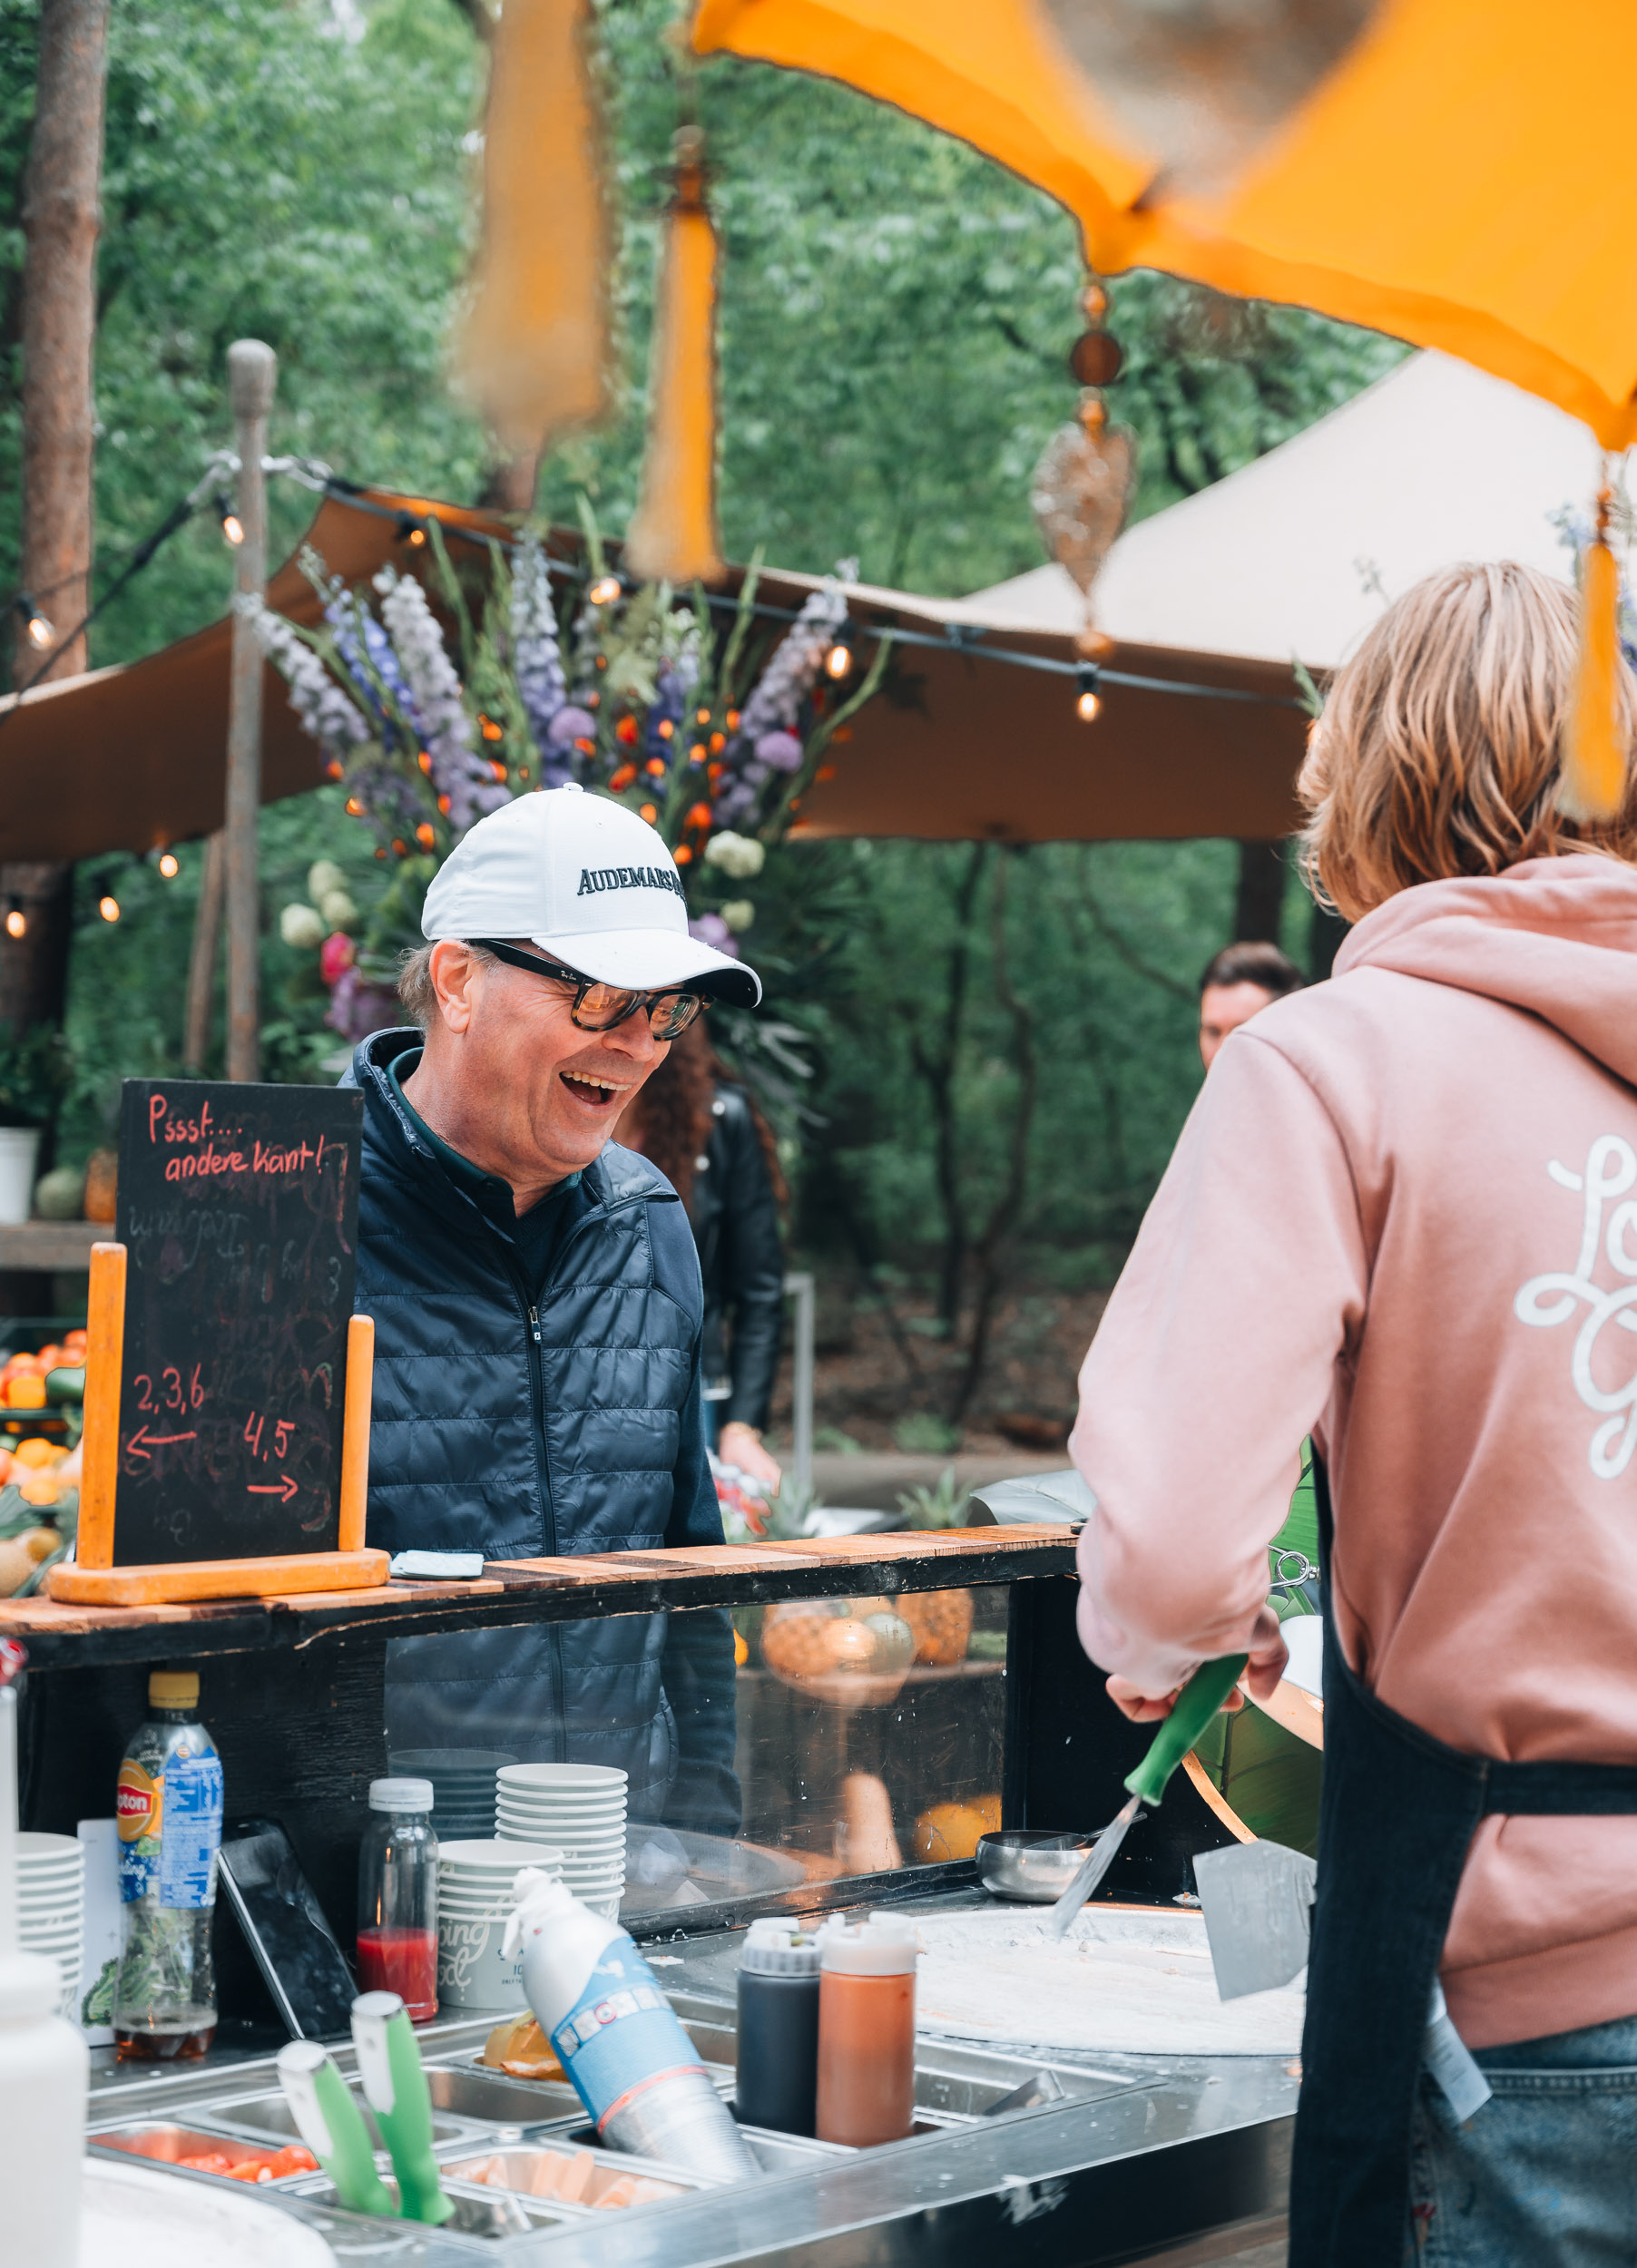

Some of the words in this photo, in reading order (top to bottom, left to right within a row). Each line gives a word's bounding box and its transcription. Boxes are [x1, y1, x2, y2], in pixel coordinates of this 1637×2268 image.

[165, 1142, 249, 1181] andere
[252, 1134, 325, 1175] kant!
[134, 1363, 204, 1415] 2,3,6
[244, 1411, 296, 1462] 4,5
